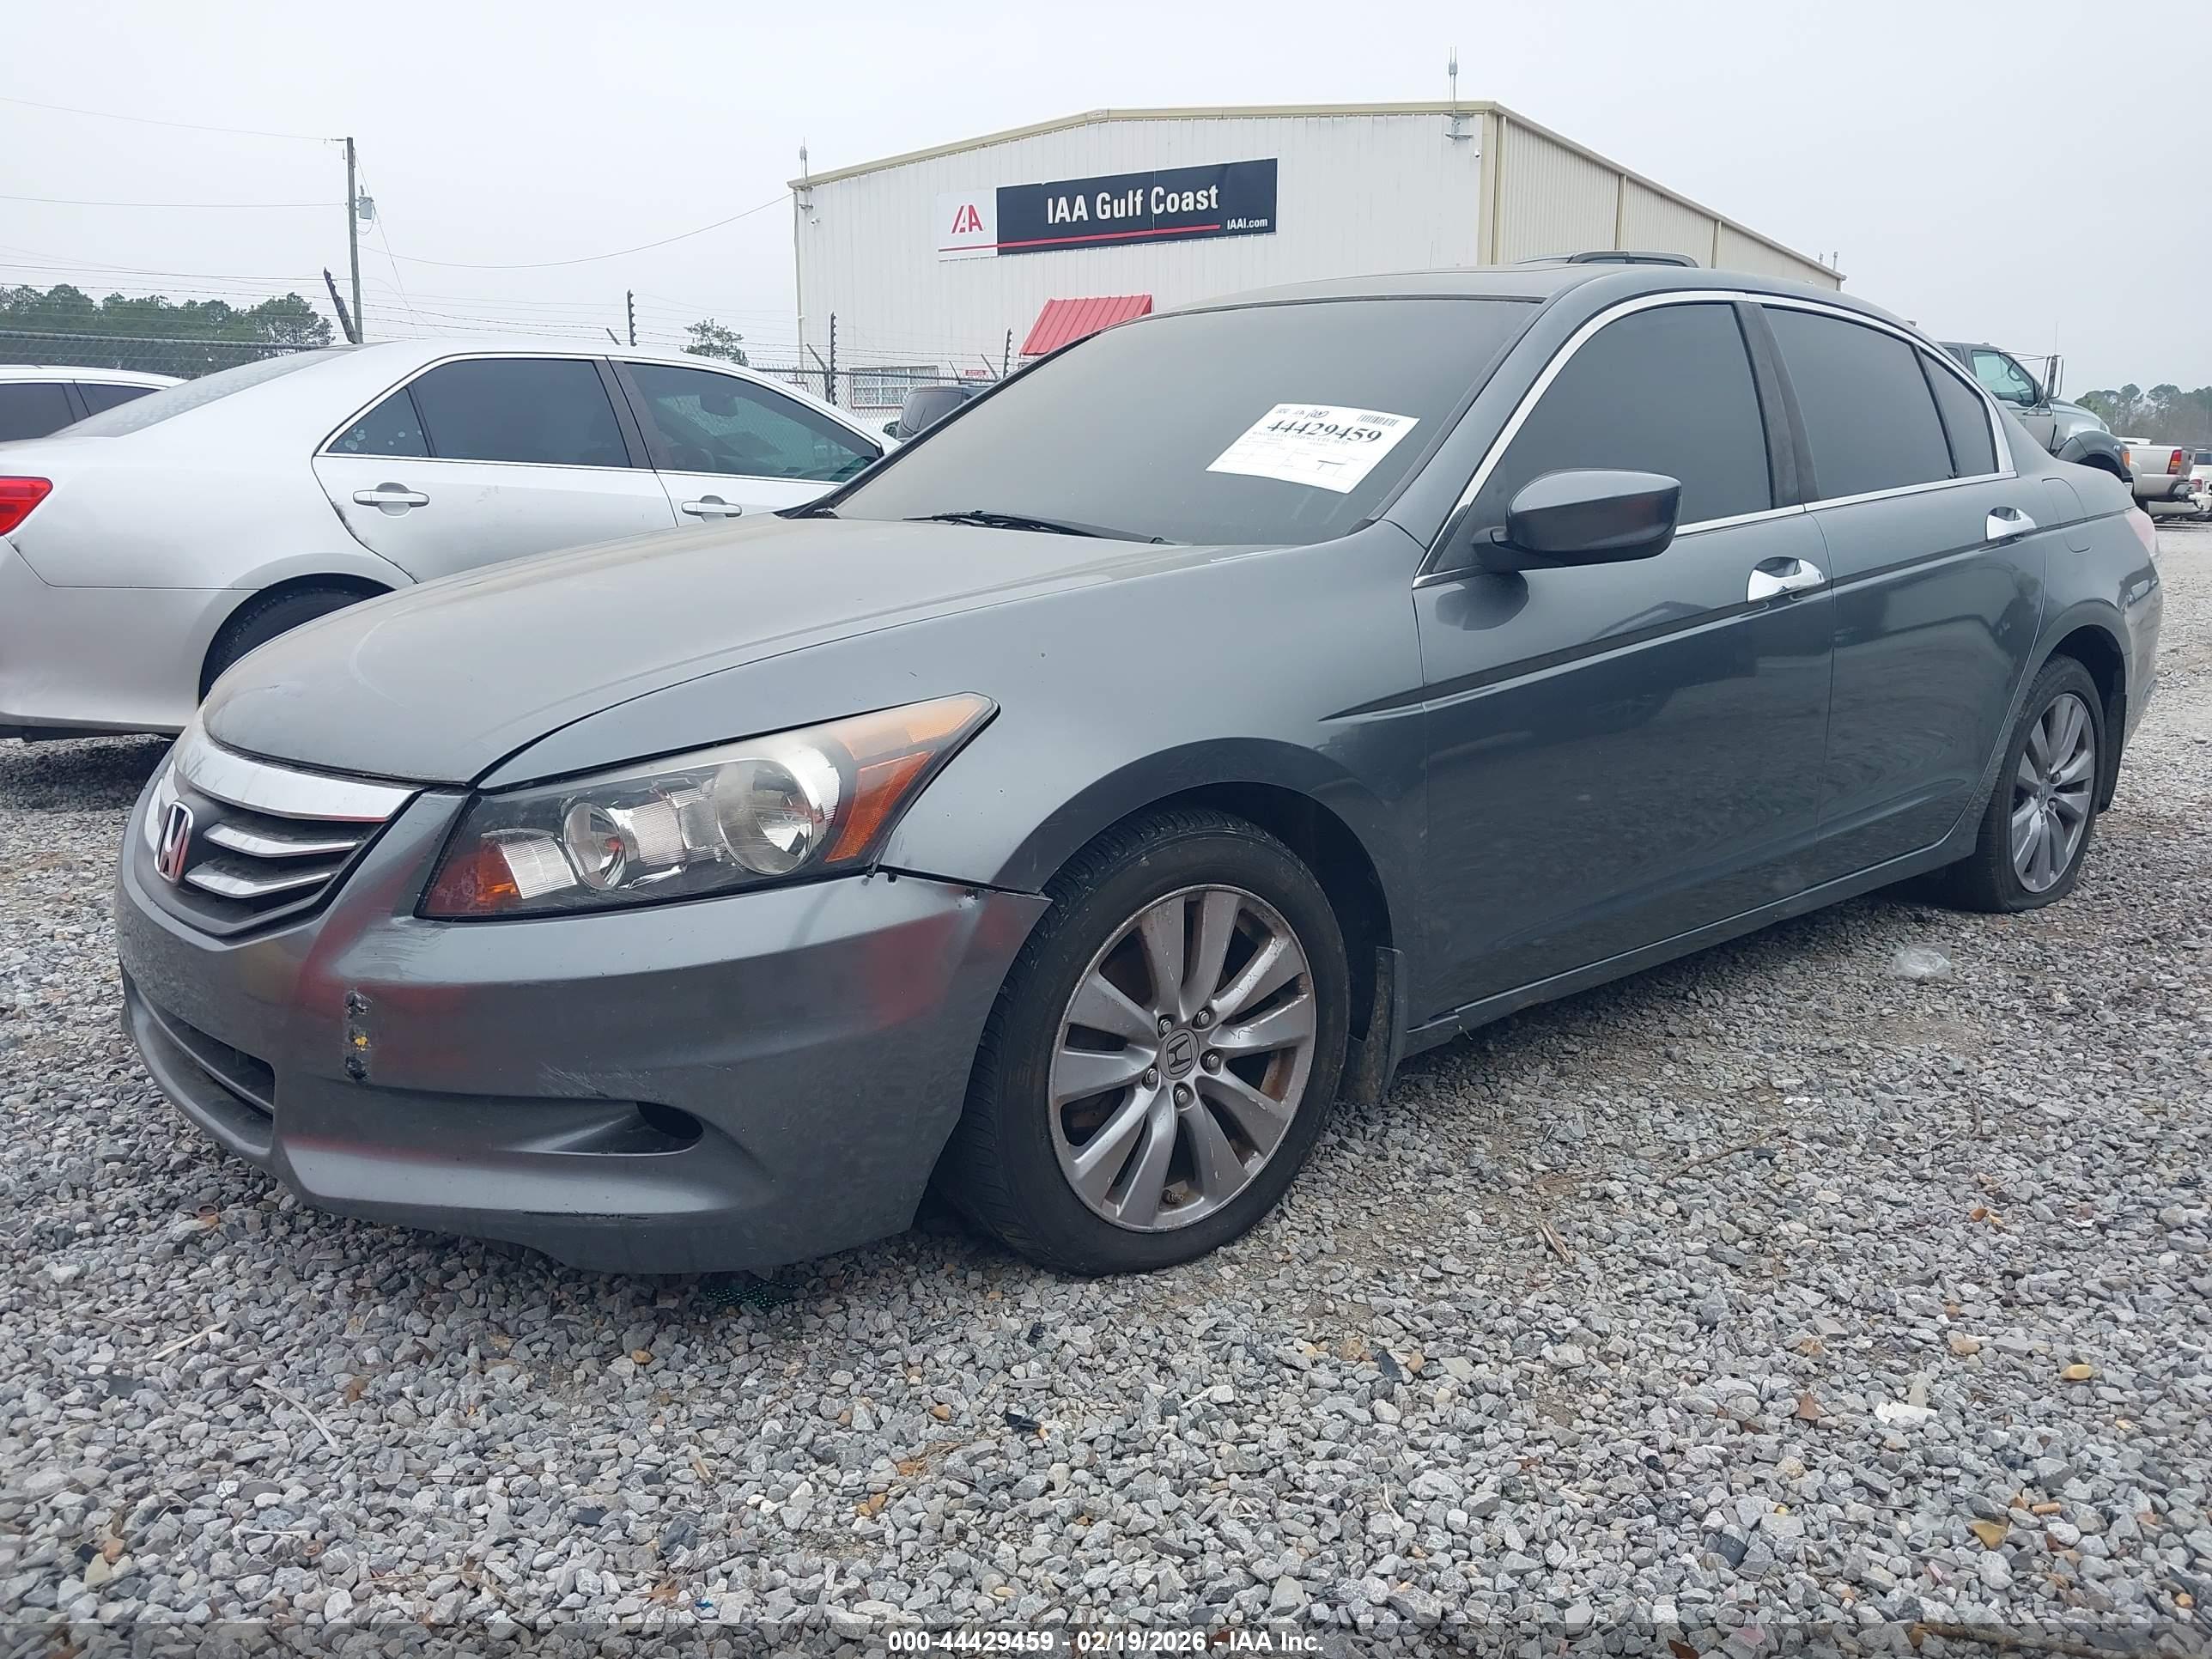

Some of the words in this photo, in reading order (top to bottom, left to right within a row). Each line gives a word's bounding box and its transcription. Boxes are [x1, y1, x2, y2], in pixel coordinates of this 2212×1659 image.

[1047, 195, 1089, 224] IAA
[1096, 189, 1143, 220] Gulf
[1151, 185, 1218, 215] Coast
[1226, 218, 1268, 230] IAAI.com
[1267, 419, 1382, 443] 44429459
